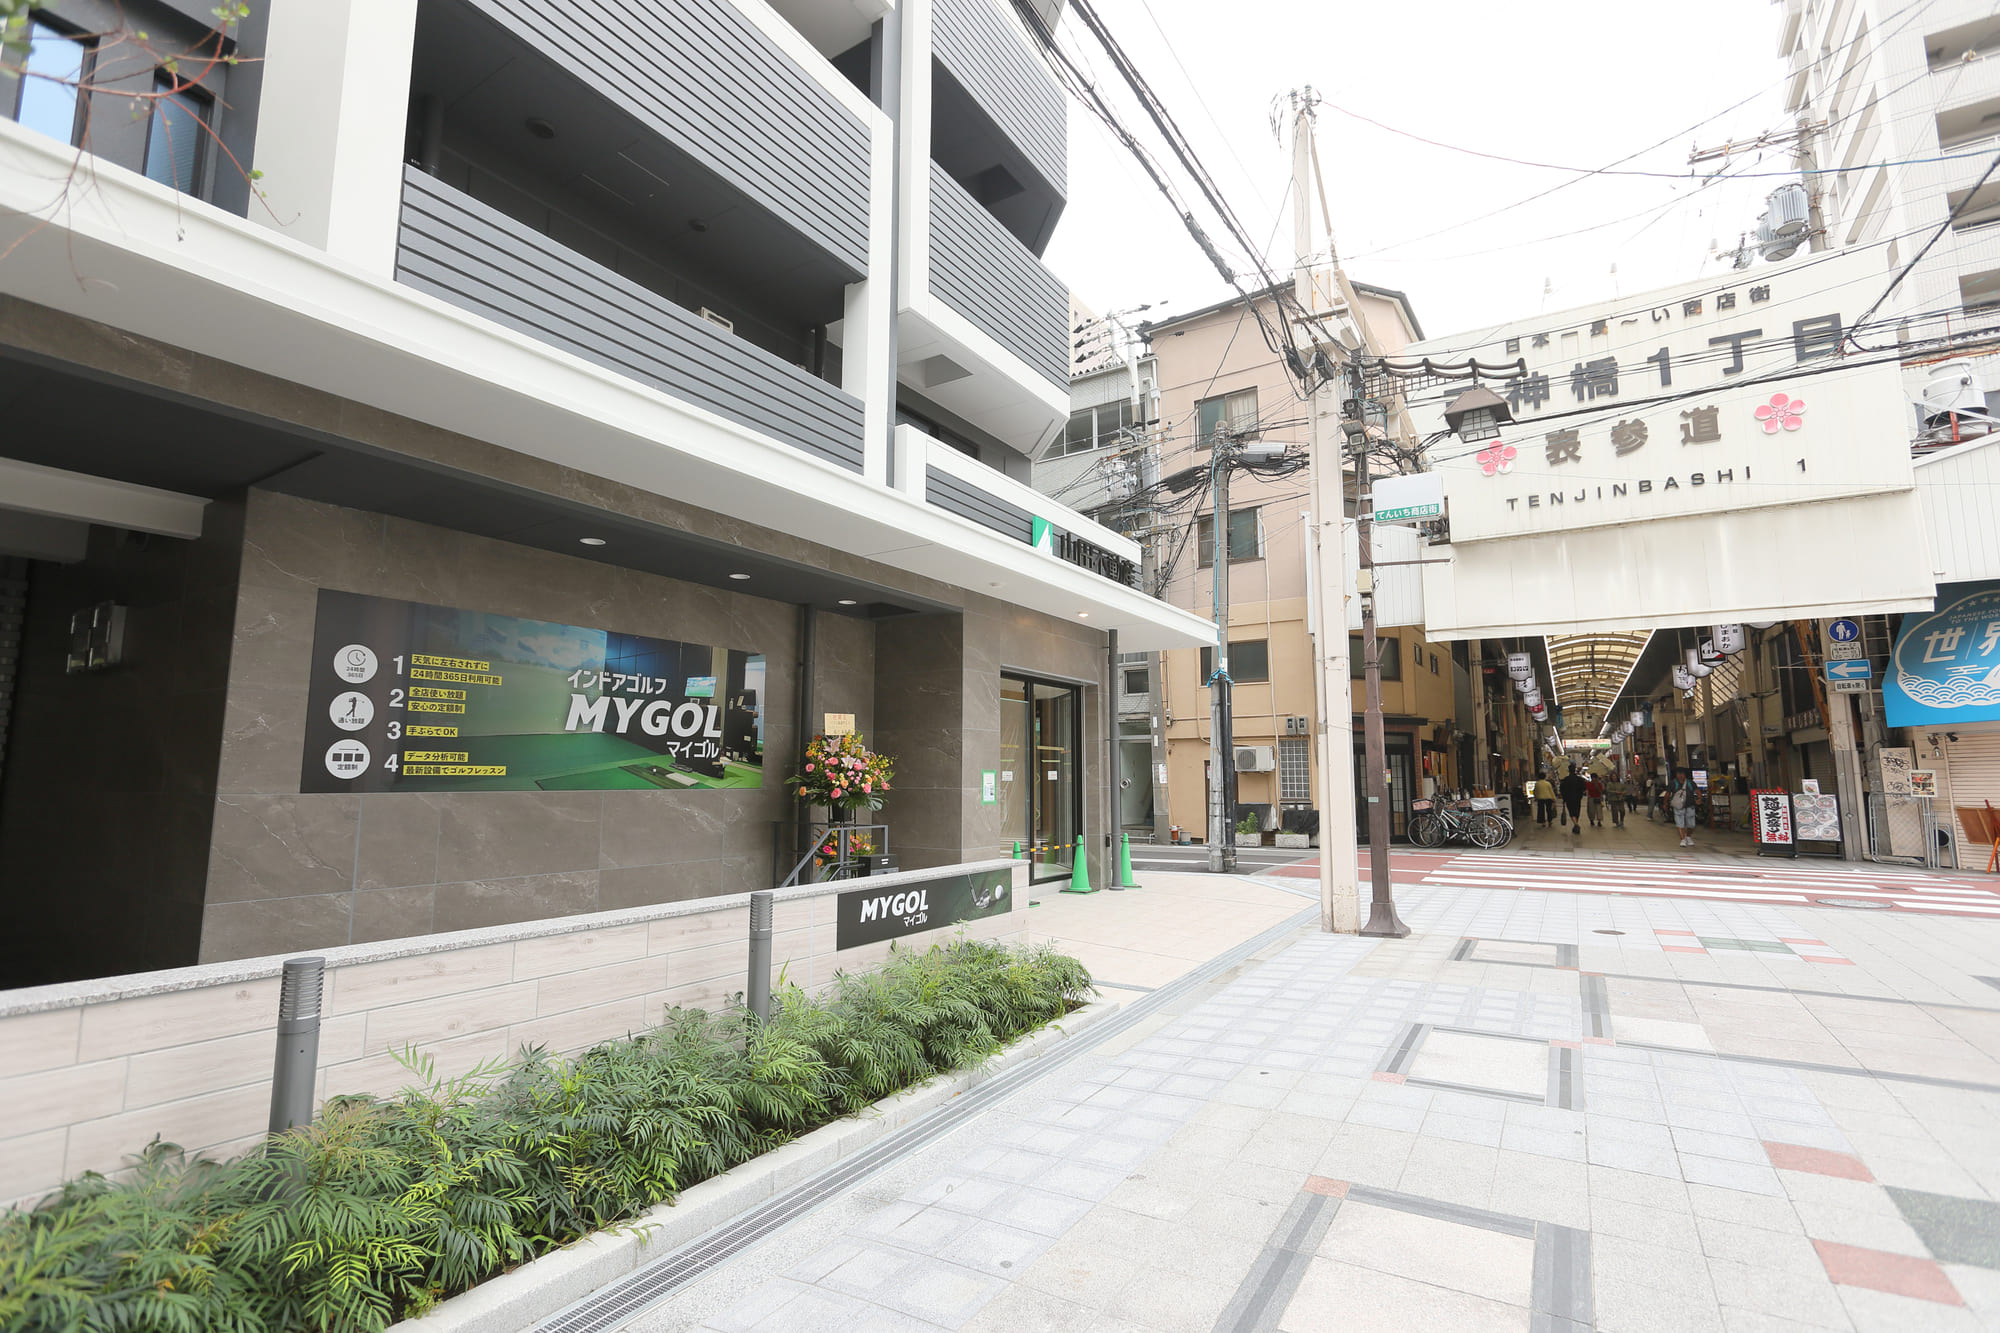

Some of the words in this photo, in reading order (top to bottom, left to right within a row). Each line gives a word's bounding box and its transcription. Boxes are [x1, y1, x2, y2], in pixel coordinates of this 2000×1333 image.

[1545, 404, 1722, 467] 表参道
[1506, 466, 1751, 511] TENJINBASHI
[1797, 458, 1807, 473] 1
[1377, 504, 1438, 520] てんいち商店街
[392, 655, 404, 675] 1
[413, 655, 488, 670] 天気に左右されずに
[412, 670, 500, 685] 24時間365日利用可能
[567, 669, 667, 695] インドアゴルフ
[389, 688, 405, 707] 2
[412, 687, 464, 700] 全店使い放題
[411, 702, 463, 712] 安心の定額制
[564, 693, 722, 738] MYGOL
[386, 720, 401, 740] 3
[407, 752, 466, 761] データ分析可能
[666, 739, 721, 759] マイゴル
[384, 753, 399, 772] 4
[406, 766, 505, 775] 最新設備でゴルフレッスン
[860, 889, 928, 923] MYGOL
[904, 911, 928, 927] マイゴル
